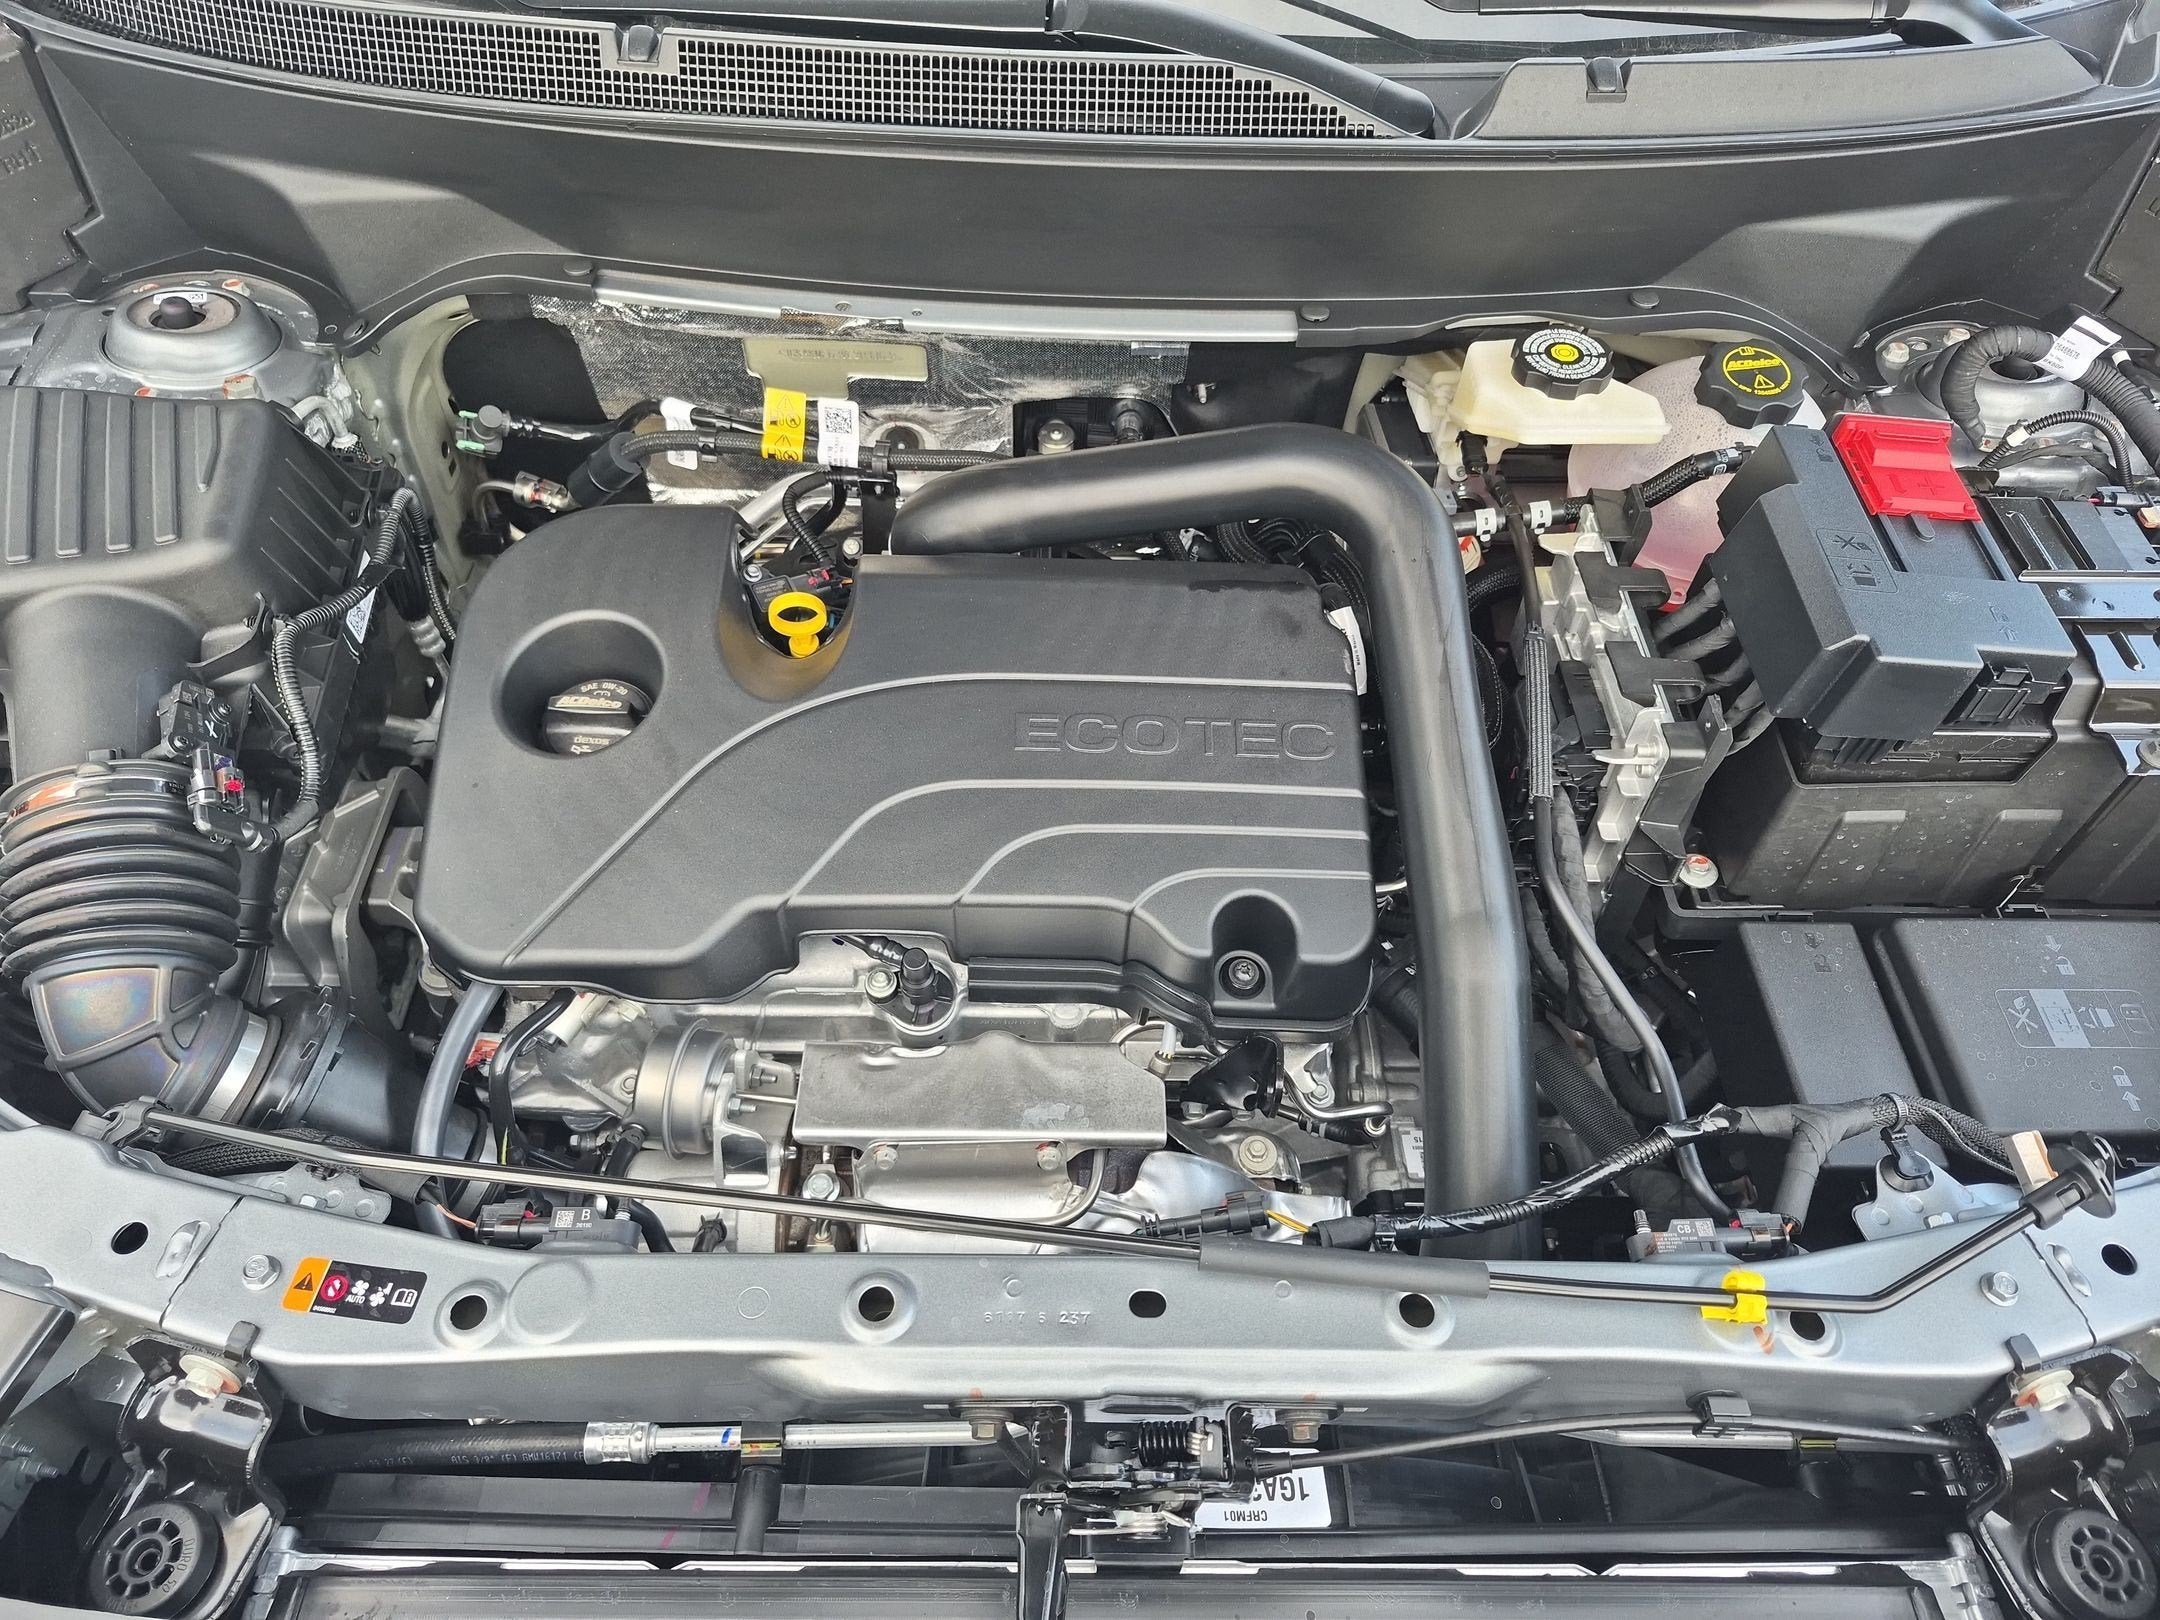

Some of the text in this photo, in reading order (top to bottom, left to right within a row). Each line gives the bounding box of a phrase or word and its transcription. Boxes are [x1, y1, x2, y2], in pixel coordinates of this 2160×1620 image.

[1727, 359, 1782, 371] ACDelco
[581, 682, 628, 696] SAE 0W-20
[555, 696, 622, 709] ACDelco
[574, 736, 610, 745] dexos
[1014, 711, 1336, 762] ECOTEC
[581, 1209, 591, 1221] B
[345, 1294, 366, 1305] AUTO
[1059, 1310, 1091, 1324] 237
[1223, 1509, 1268, 1522] CRFM01
